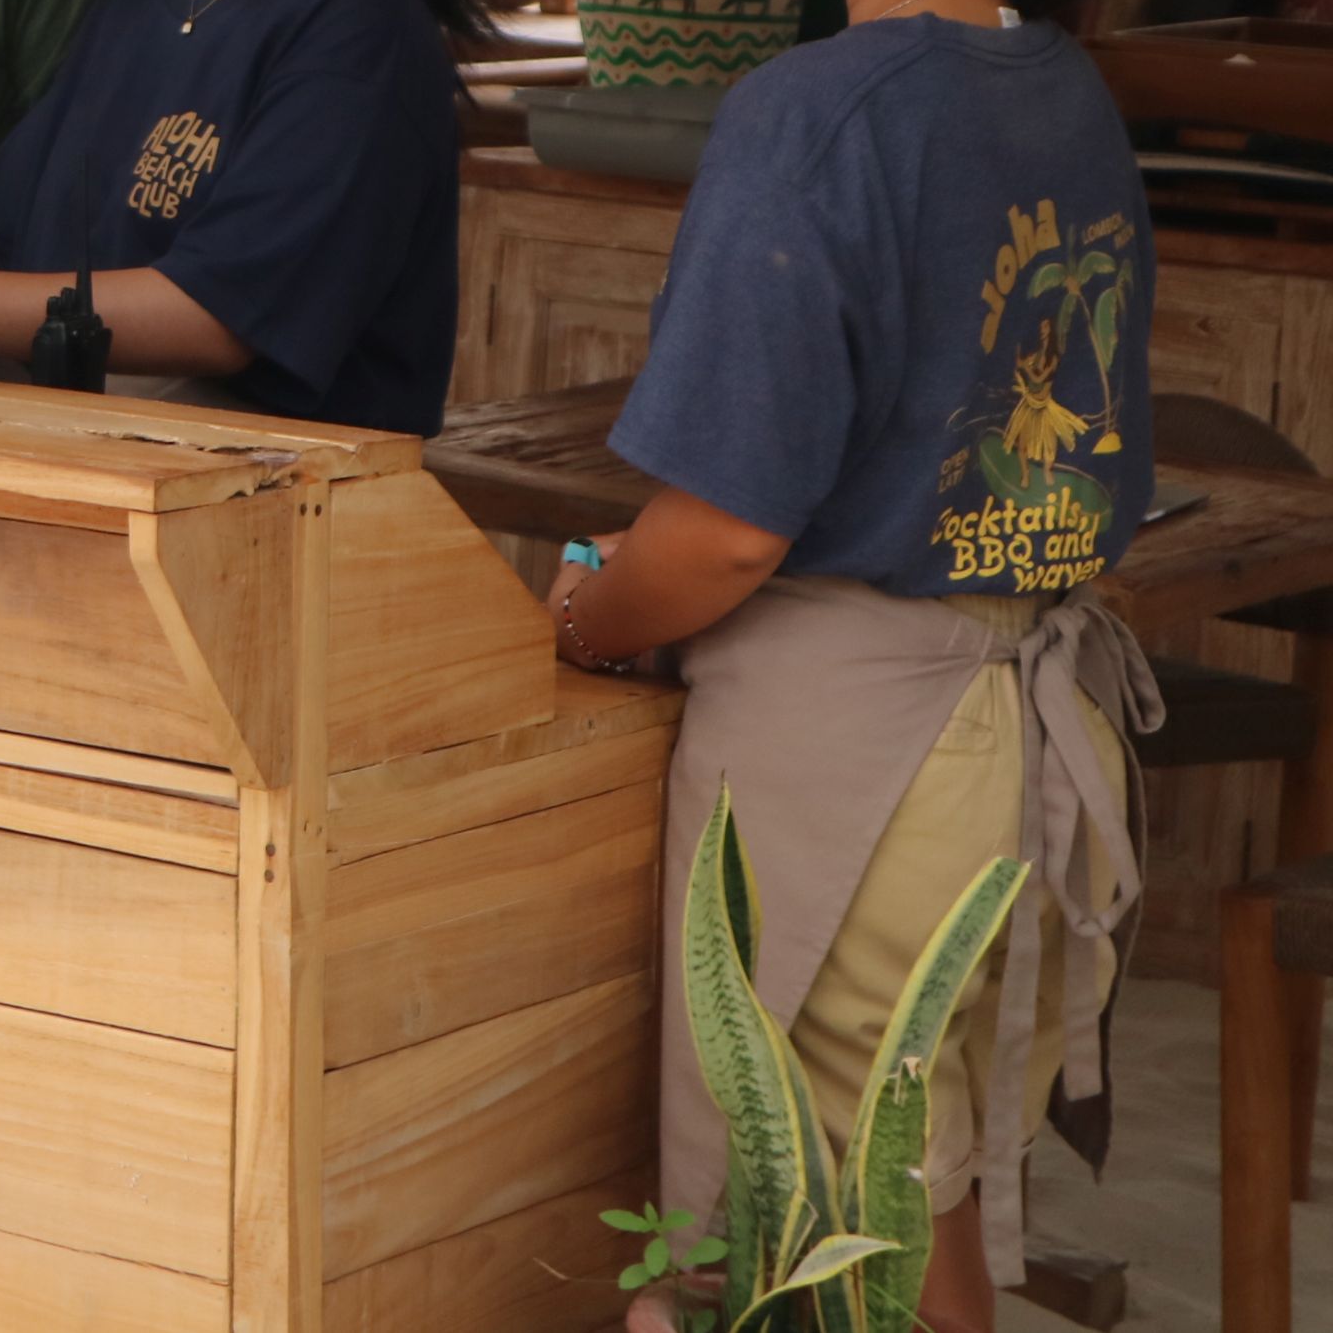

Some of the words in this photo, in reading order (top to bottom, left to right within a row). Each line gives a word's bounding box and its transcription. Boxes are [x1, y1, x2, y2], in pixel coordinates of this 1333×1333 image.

[142, 111, 221, 173] ALOHA
[133, 151, 201, 199] BEACH
[127, 181, 181, 219] CLUB
[948, 533, 1032, 581] BBQ
[1044, 513, 1101, 558] and
[1012, 556, 1106, 594] waves
